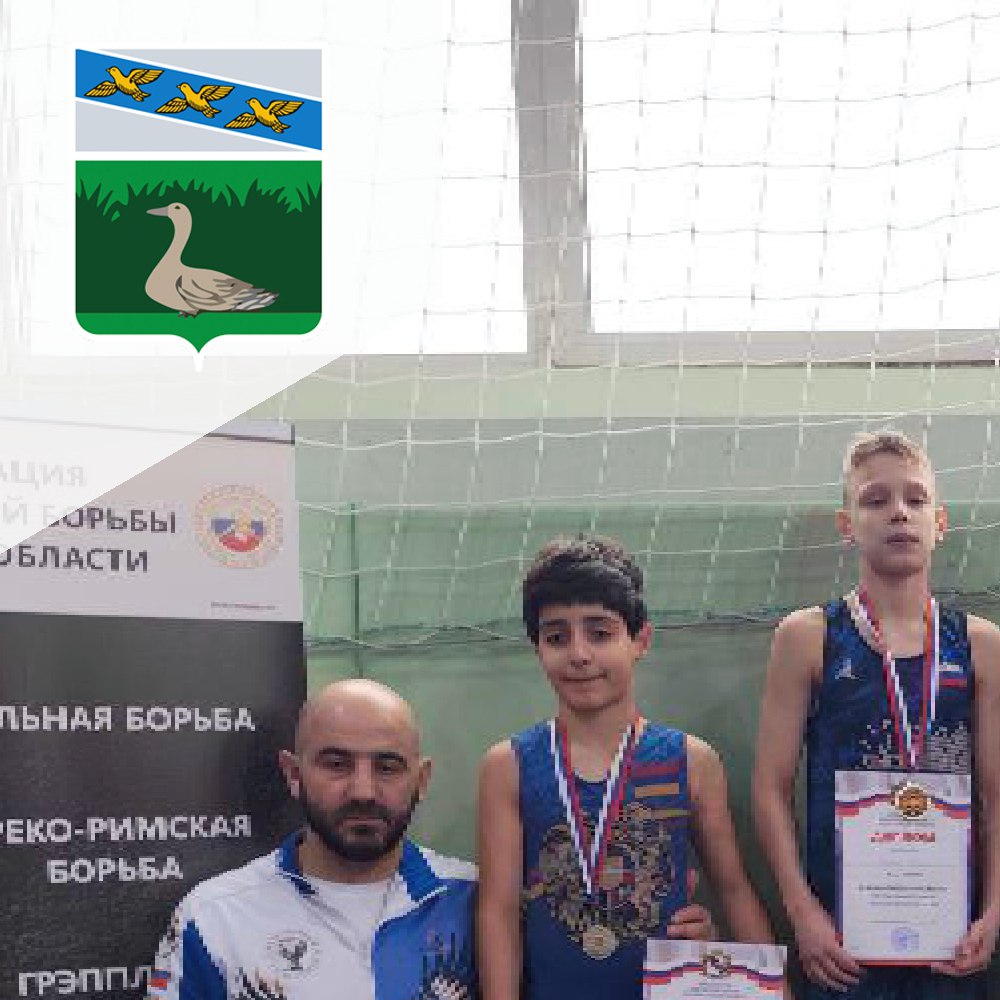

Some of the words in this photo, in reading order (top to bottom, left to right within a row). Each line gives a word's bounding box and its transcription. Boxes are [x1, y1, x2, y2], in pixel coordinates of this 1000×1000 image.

[126, 707, 255, 731] БОРЬБА
[0, 814, 252, 844] ЕКО-РИМСКАЯ
[47, 856, 183, 883] БОРЬБА
